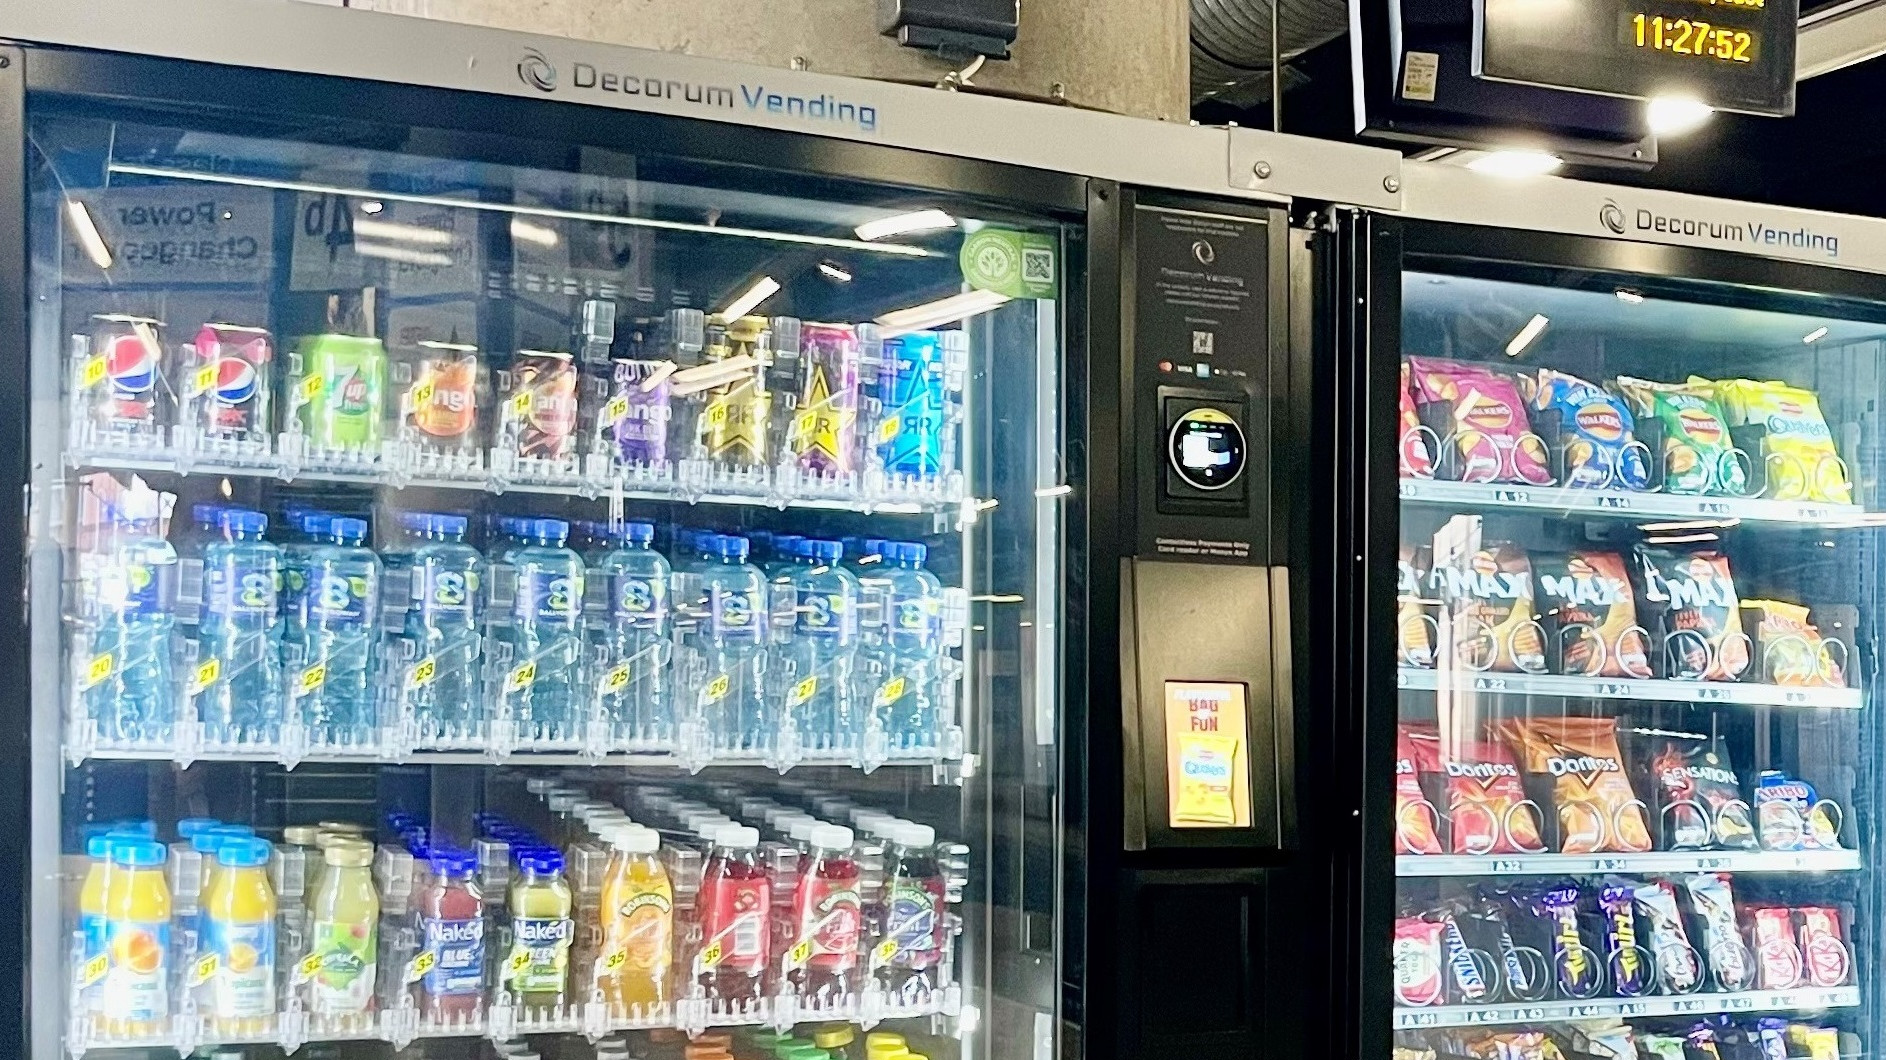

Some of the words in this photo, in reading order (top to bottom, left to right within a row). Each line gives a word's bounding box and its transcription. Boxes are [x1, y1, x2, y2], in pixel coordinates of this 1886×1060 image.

[1633, 13, 1752, 63] 11:27:52
[572, 62, 734, 108] Decorum
[740, 84, 876, 131] Vending
[1636, 208, 1743, 243] Decorum
[1748, 221, 1838, 257] Vending
[88, 361, 104, 380] 10
[199, 373, 214, 387] 11
[307, 376, 323, 394] 12
[416, 385, 432, 402] 13
[516, 394, 531, 410] 14
[613, 400, 627, 415] 15
[628, 402, 673, 425] ango
[712, 406, 725, 422] 16
[800, 415, 813, 430] 17
[92, 661, 109, 676] 20
[200, 664, 216, 681] 21
[416, 663, 434, 680] 23
[516, 667, 533, 683] 24
[610, 668, 628, 685] 25
[305, 669, 324, 686] 22
[711, 678, 727, 695] 26
[800, 680, 815, 696] 27
[887, 682, 903, 698] 28
[1444, 761, 1518, 778] Doritos
[1547, 757, 1619, 777] Doritos
[1757, 784, 1808, 798] ARIBO
[513, 953, 530, 969] 34
[608, 952, 625, 967] 35
[704, 945, 720, 962] 36
[791, 944, 809, 961] 37
[87, 958, 106, 977] 30
[198, 958, 216, 974] 31
[303, 955, 320, 971] 32
[416, 953, 434, 971] 33
